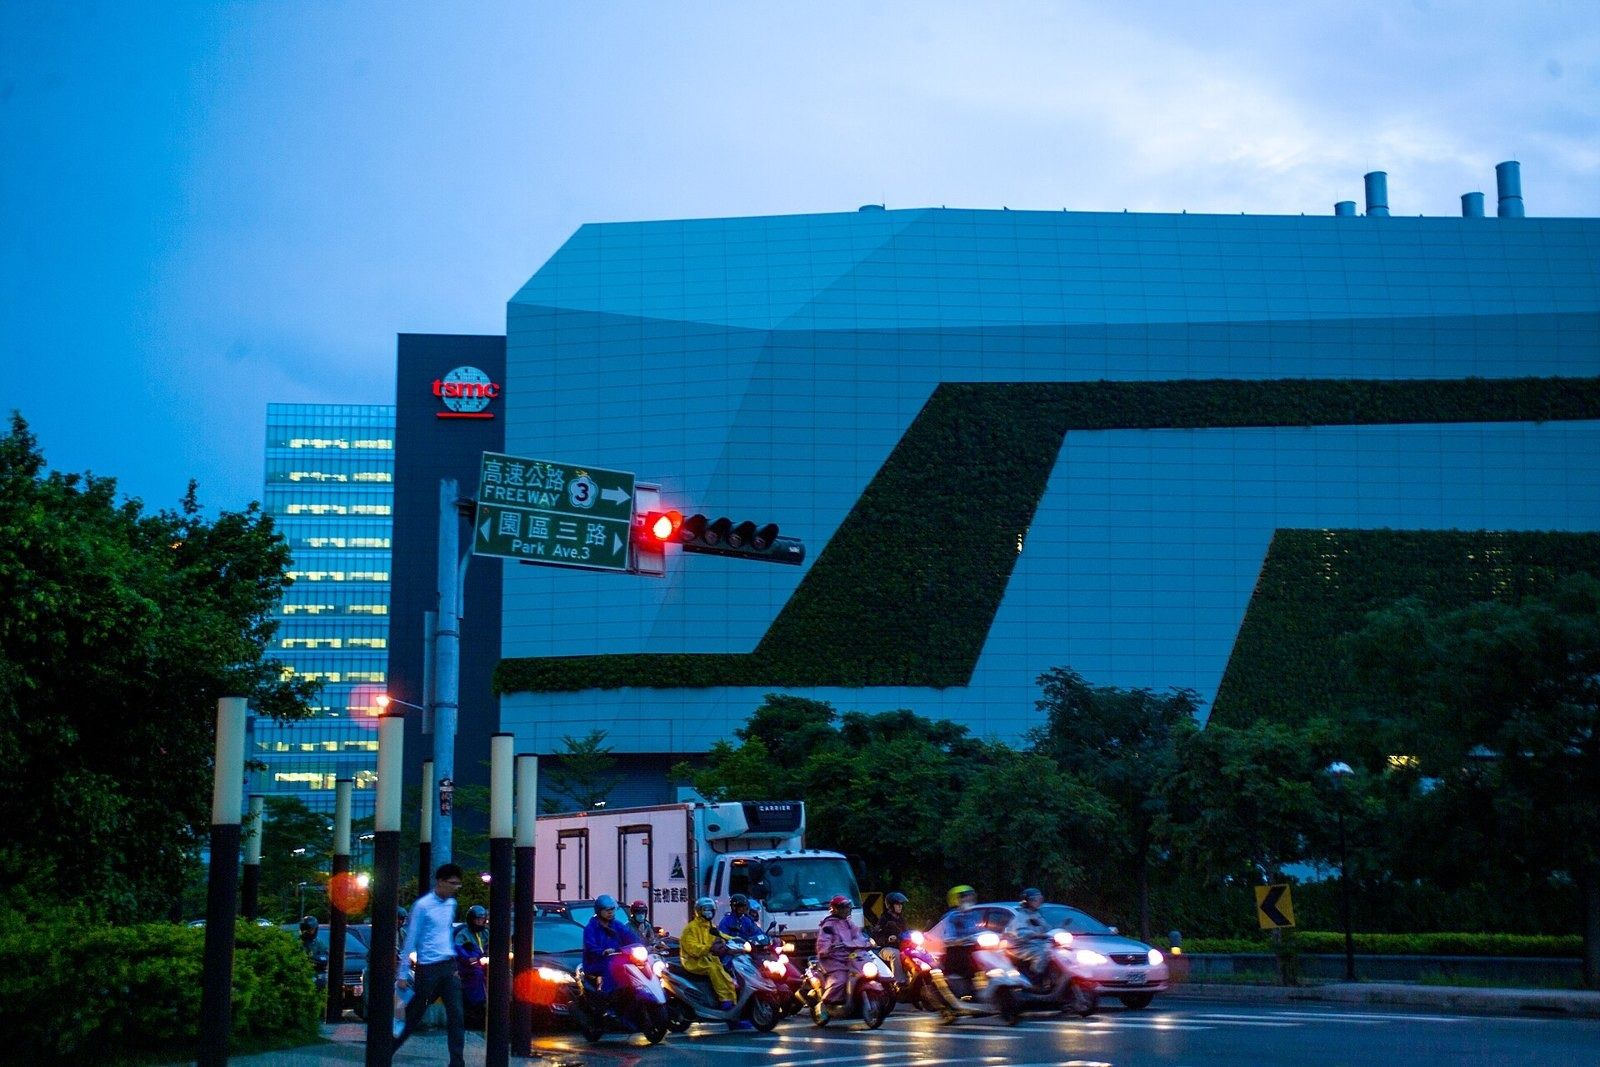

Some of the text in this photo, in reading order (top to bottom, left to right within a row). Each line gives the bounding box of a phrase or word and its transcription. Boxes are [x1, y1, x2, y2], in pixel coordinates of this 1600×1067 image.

[432, 380, 500, 398] tsmc
[484, 460, 564, 491] 高速公路
[484, 485, 560, 506] FREEWAY
[574, 482, 589, 501] 3
[498, 510, 606, 546] 園區三路
[511, 540, 590, 559] Park Ave.3
